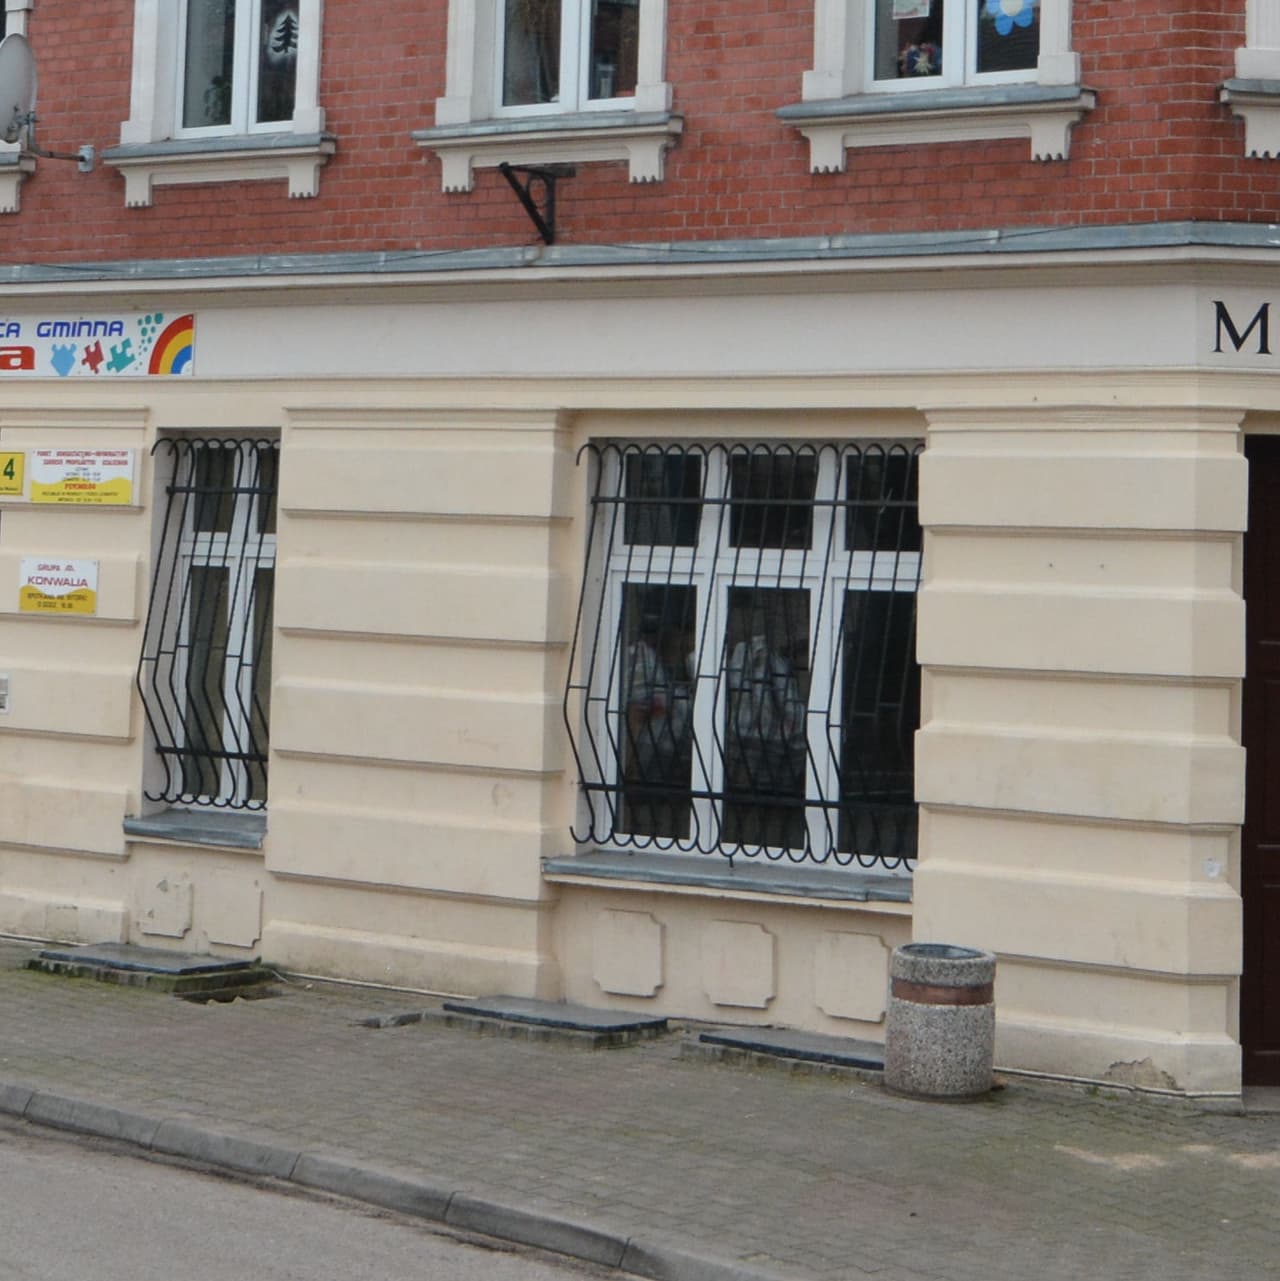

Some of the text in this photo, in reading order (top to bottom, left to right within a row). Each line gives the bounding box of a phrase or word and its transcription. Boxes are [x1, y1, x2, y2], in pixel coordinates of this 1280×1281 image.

[36, 319, 124, 339] GMINNA
[3, 458, 15, 480] 4
[27, 575, 89, 588] KONWALIA
